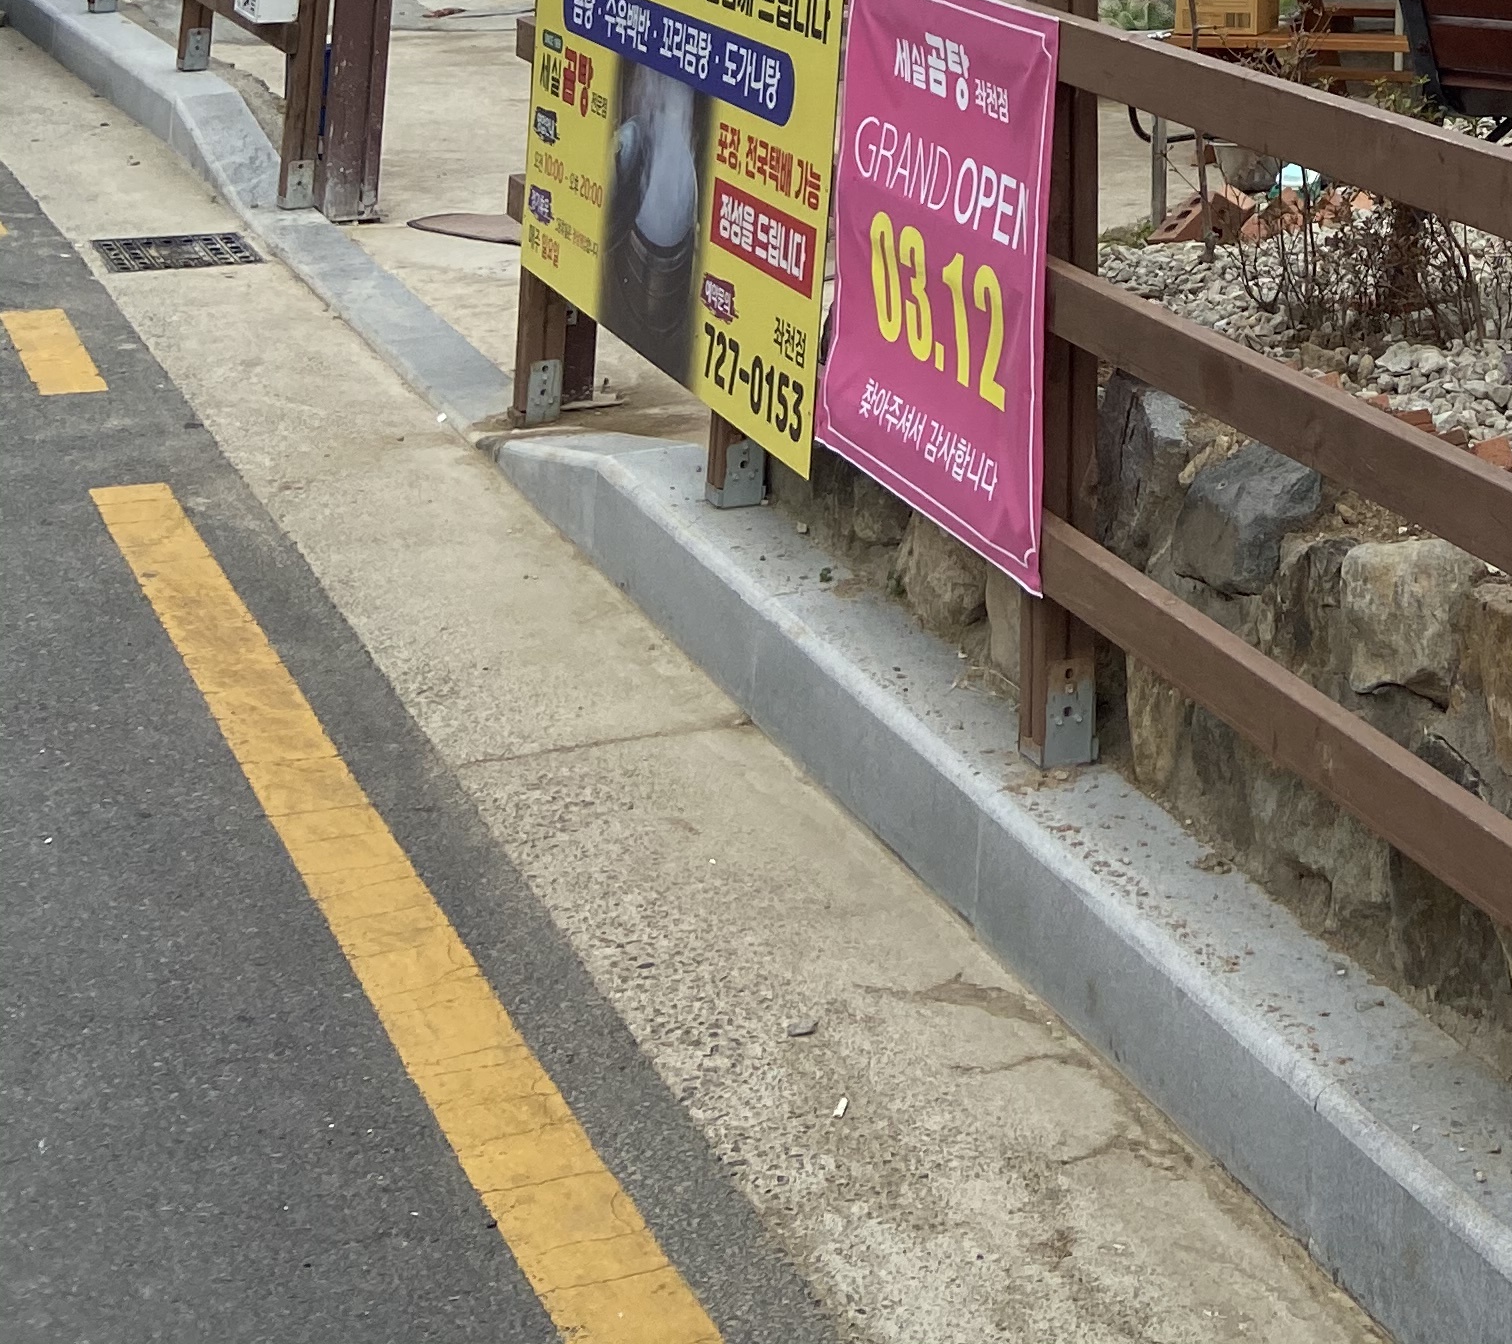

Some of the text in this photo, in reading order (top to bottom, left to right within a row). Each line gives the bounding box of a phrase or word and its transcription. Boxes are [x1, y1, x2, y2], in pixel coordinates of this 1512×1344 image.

[660, 17, 712, 79] 꼬리곰탕
[722, 42, 781, 110] 도가니탕
[974, 78, 1010, 123] 좌천점
[544, 152, 564, 184] 10:00
[579, 174, 604, 208] 20:00
[745, 135, 794, 198] 전국택배
[795, 159, 822, 211] 가능
[854, 116, 1030, 255] GRAND OPEN
[719, 194, 807, 281] 정성을 드립니다
[773, 316, 807, 368] 좌천점
[870, 211, 1006, 412] 03.12
[704, 321, 805, 443] 727-0153
[858, 377, 999, 502] 찾아주셔서 감사합니다
